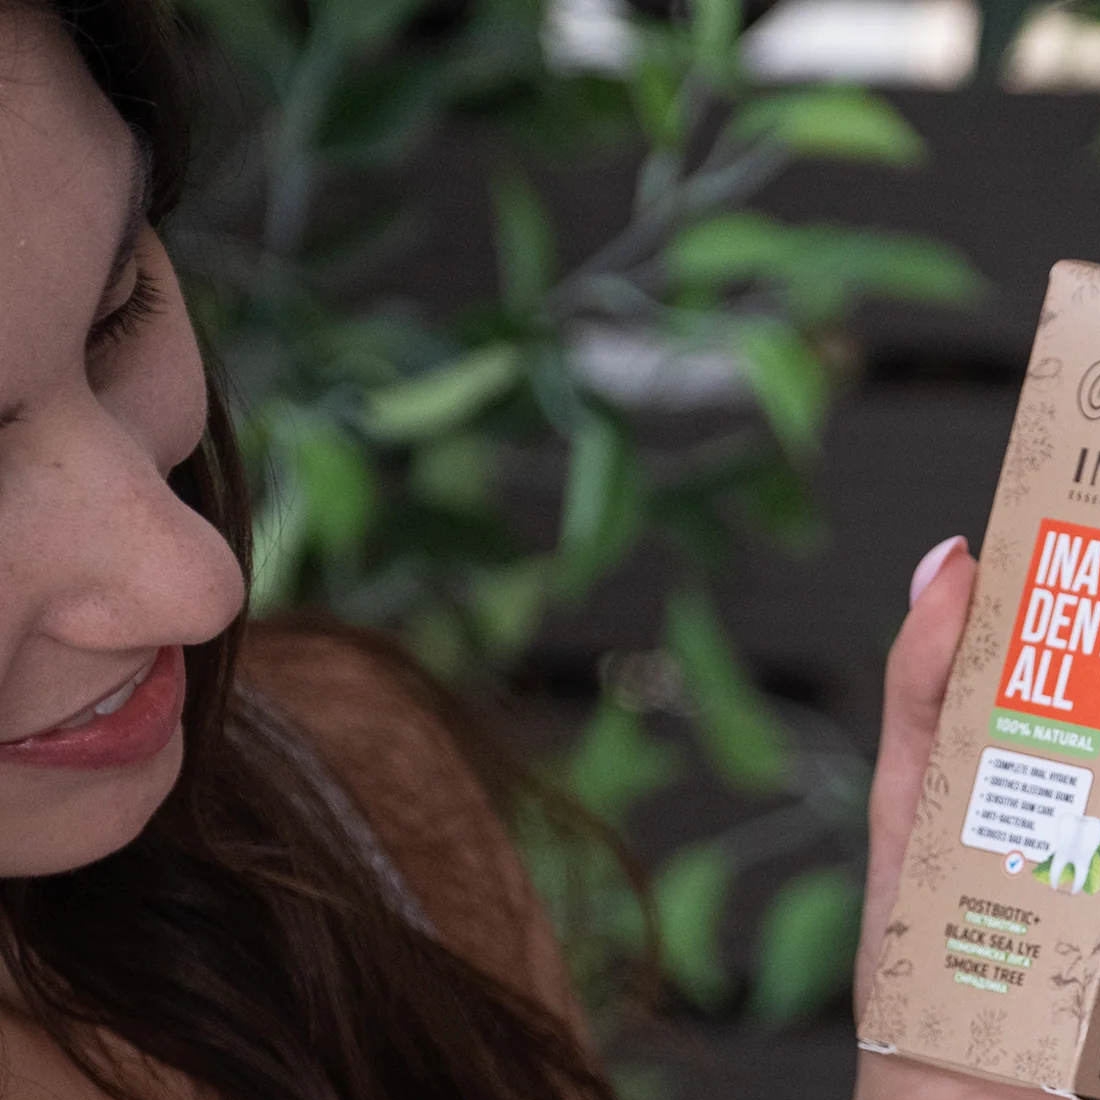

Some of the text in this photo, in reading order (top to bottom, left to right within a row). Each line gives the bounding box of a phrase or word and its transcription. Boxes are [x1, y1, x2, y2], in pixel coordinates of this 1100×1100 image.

[1005, 645, 1073, 711] ALL
[995, 716, 1094, 752] 100% NATURAL
[945, 922, 986, 944] BLACK
[989, 934, 1014, 952] SEA
[1017, 941, 1041, 959] LYE
[944, 954, 988, 978] SMOKE
[993, 966, 1025, 987] TREE
